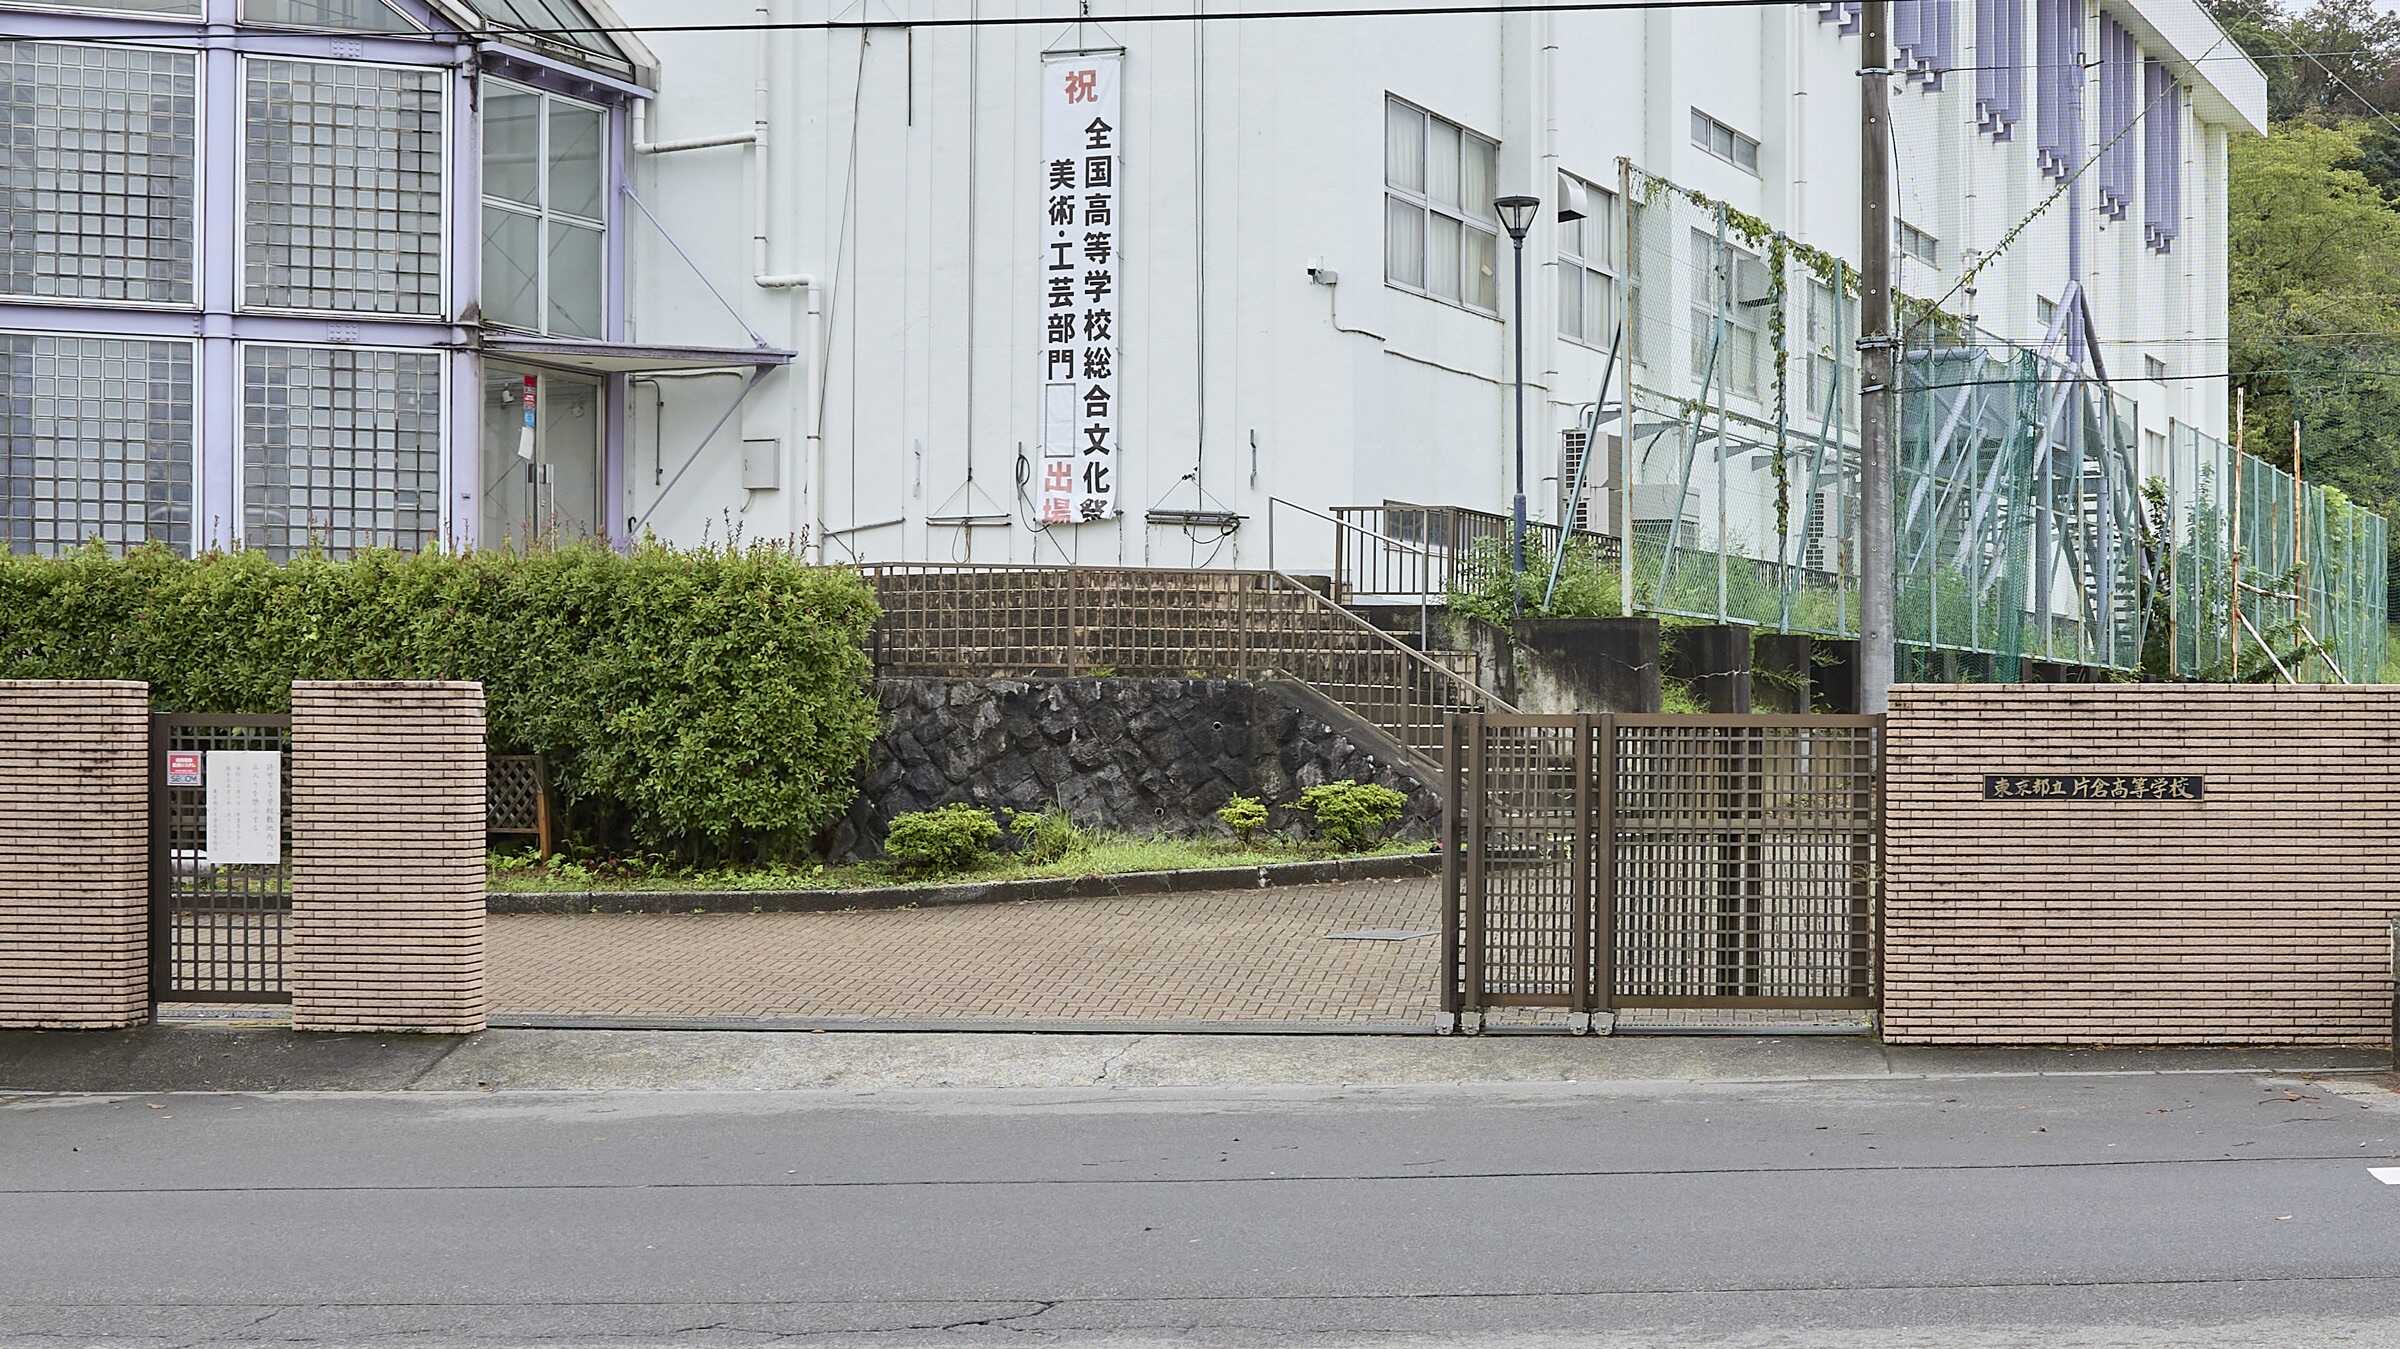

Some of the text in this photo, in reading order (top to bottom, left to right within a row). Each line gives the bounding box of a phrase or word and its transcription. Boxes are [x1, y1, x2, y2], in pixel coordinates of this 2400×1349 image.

[1065, 70, 1098, 105] 祝
[1042, 158, 1076, 524] 美術・工芸部門 出場
